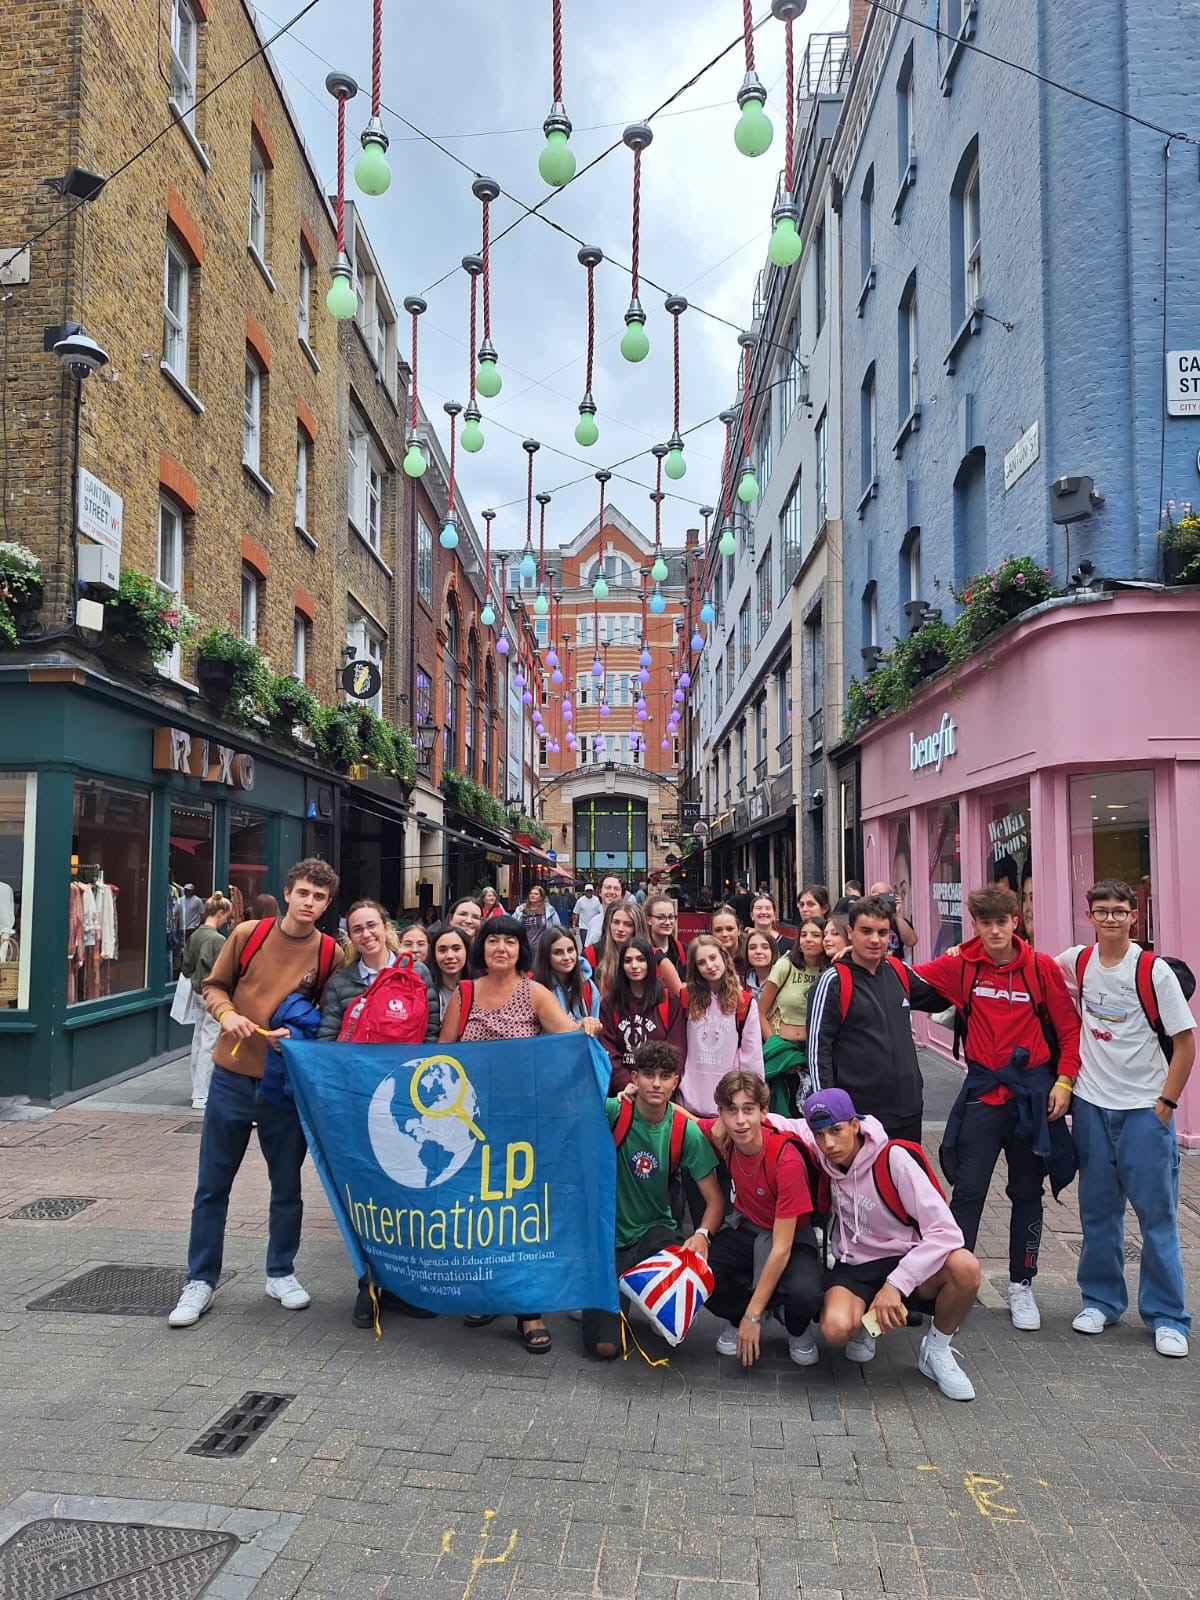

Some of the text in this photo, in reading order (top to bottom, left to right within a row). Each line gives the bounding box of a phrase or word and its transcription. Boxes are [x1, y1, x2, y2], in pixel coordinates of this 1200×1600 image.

[1180, 403, 1197, 411] CITY
[84, 477, 111, 508] GANTON
[83, 496, 120, 534] STREET W1
[168, 727, 255, 792] RIXO
[908, 712, 958, 772] benefit
[988, 819, 1004, 842] We
[993, 831, 1028, 863] Brows
[480, 1141, 535, 1201] LP
[345, 1183, 549, 1251] International
[418, 1256, 449, 1268] Agenzia
[451, 1256, 460, 1266] di
[462, 1252, 515, 1266] Educational
[517, 1250, 555, 1262] Tourism
